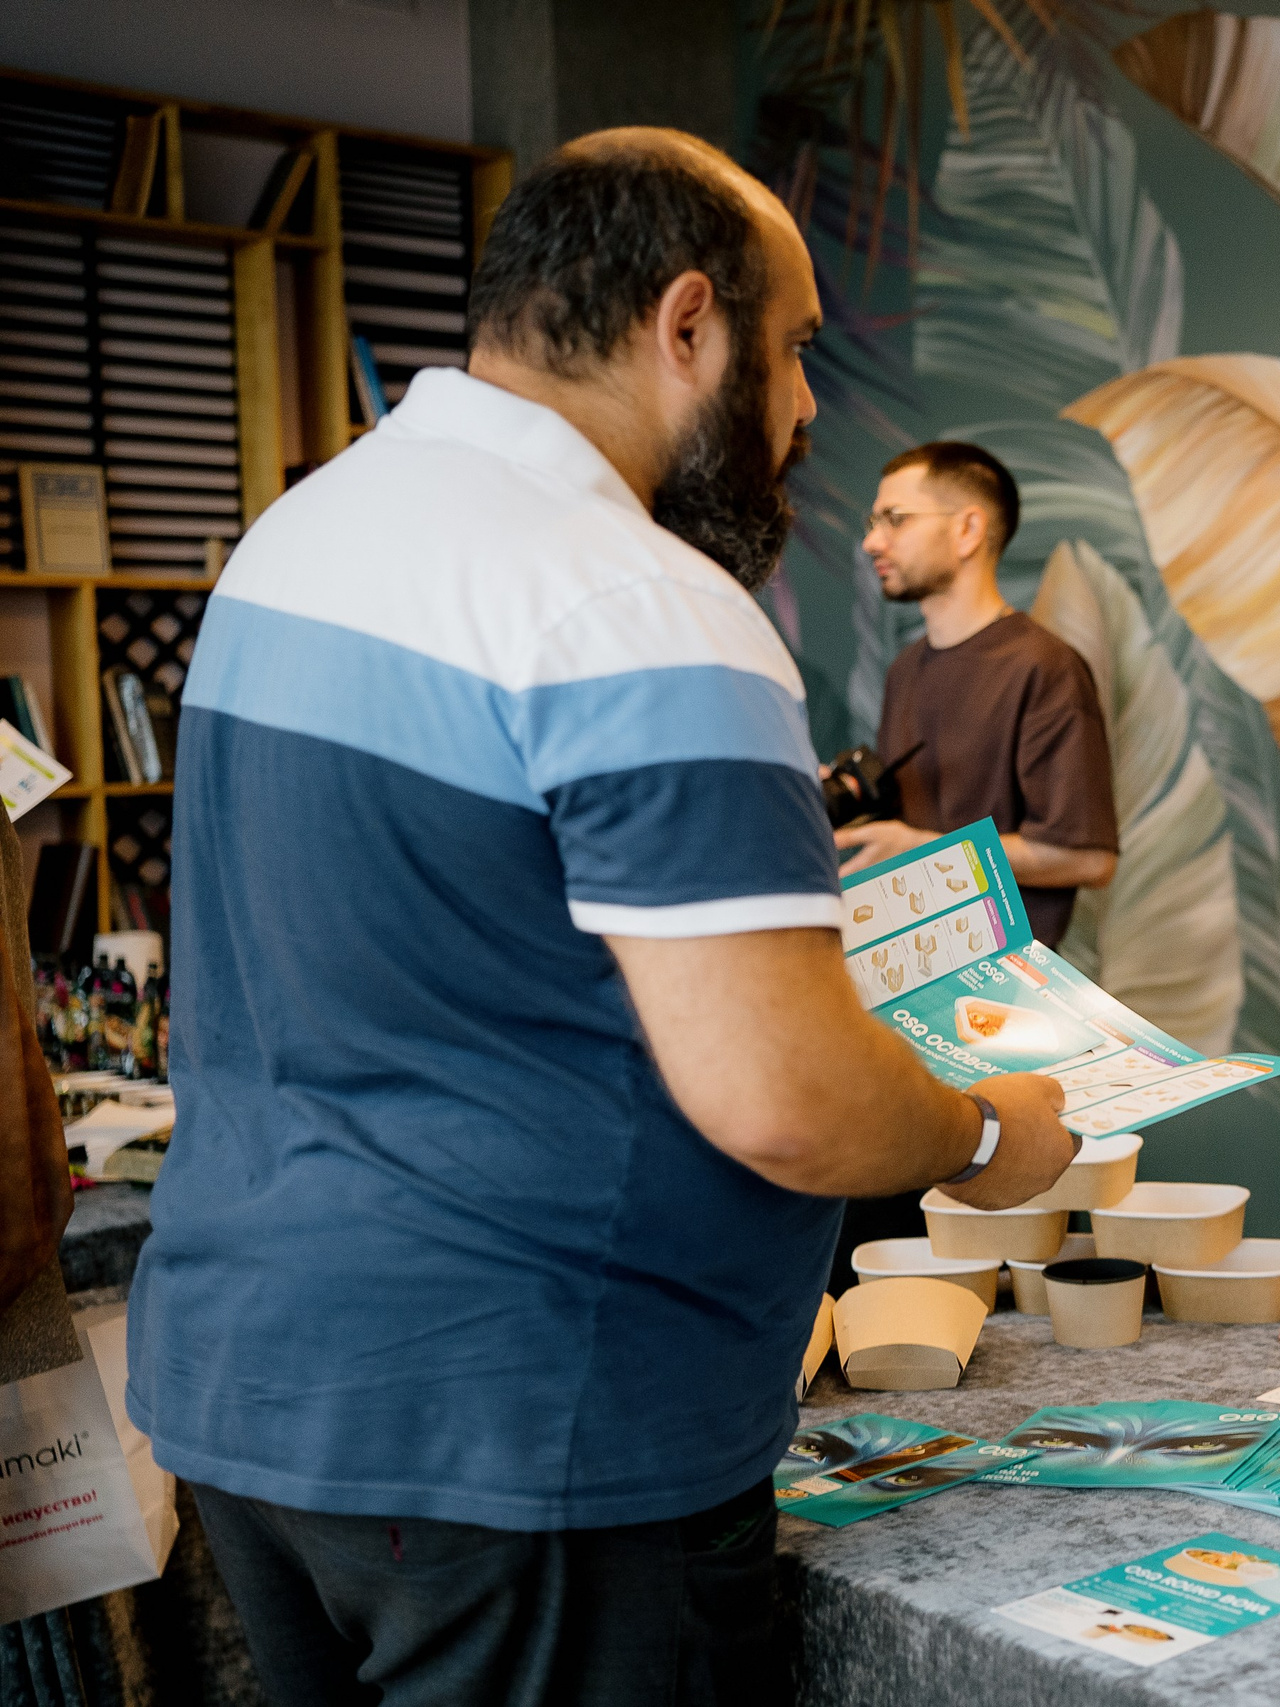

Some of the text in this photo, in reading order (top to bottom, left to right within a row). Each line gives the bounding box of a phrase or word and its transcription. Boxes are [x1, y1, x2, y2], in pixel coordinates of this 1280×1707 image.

[978, 961, 1005, 983] OSQ
[893, 1009, 929, 1037] OSQ
[925, 1034, 1003, 1074] OCTOBOX
[2, 1488, 98, 1528] искусство!
